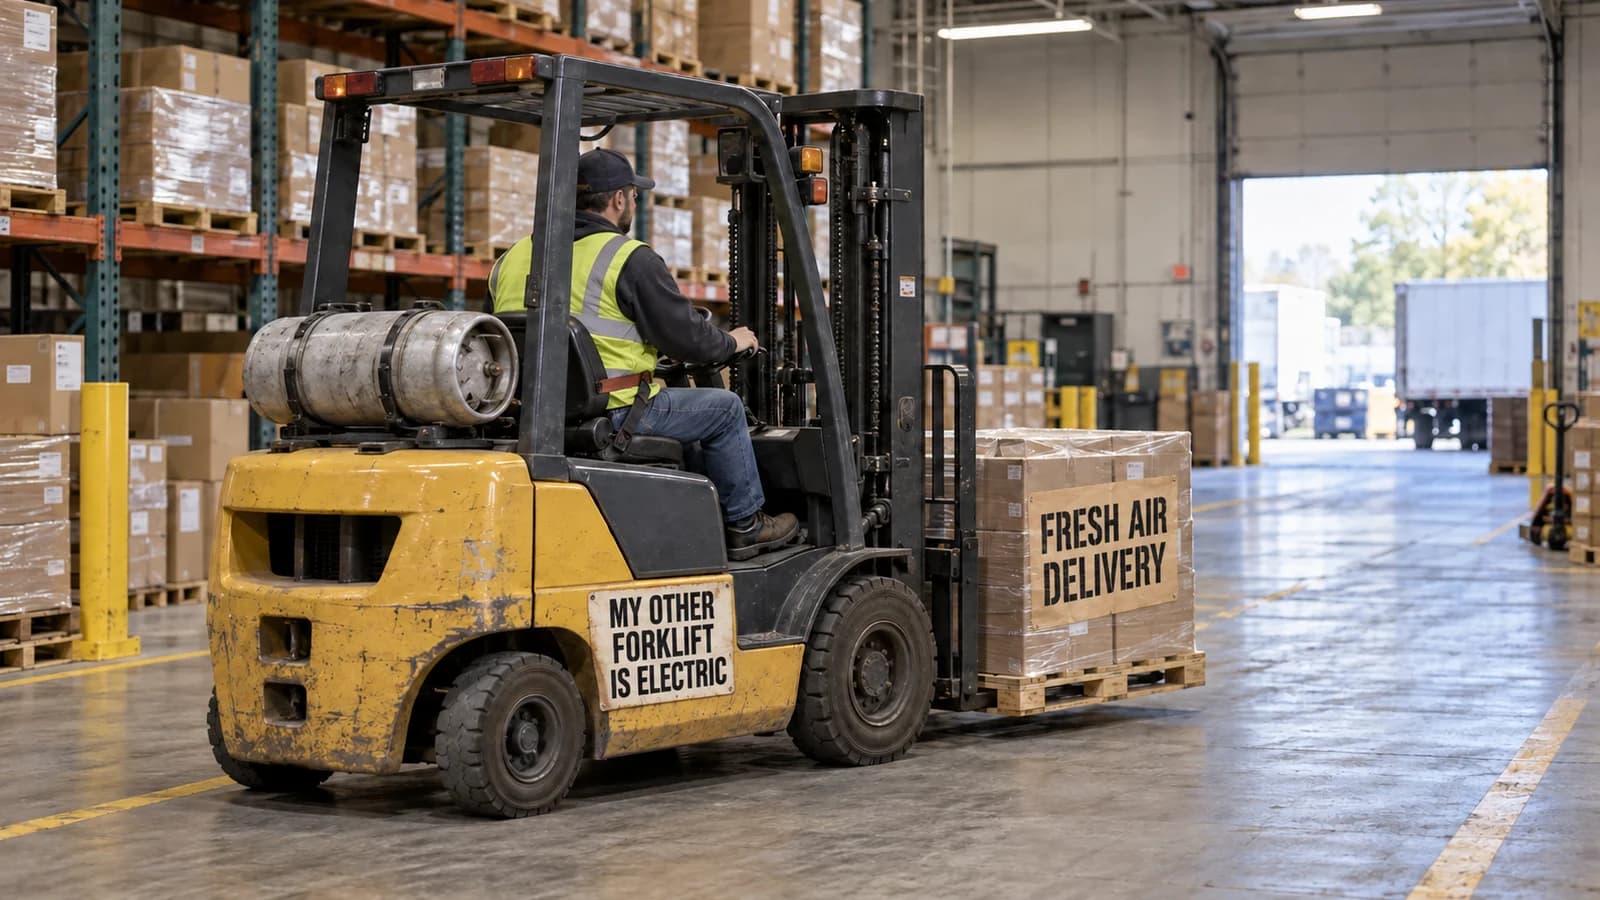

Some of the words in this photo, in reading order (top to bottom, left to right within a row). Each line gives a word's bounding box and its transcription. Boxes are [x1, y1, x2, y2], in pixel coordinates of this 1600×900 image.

[1040, 504, 1120, 555] FRESH
[1128, 496, 1168, 540] AIR
[1043, 541, 1166, 607] DELIVERY
[609, 596, 642, 629] MY
[649, 590, 715, 625] OTHER
[612, 623, 714, 664] FORKLIFT
[610, 667, 631, 699] IS
[637, 656, 727, 696] ELECTRIC
